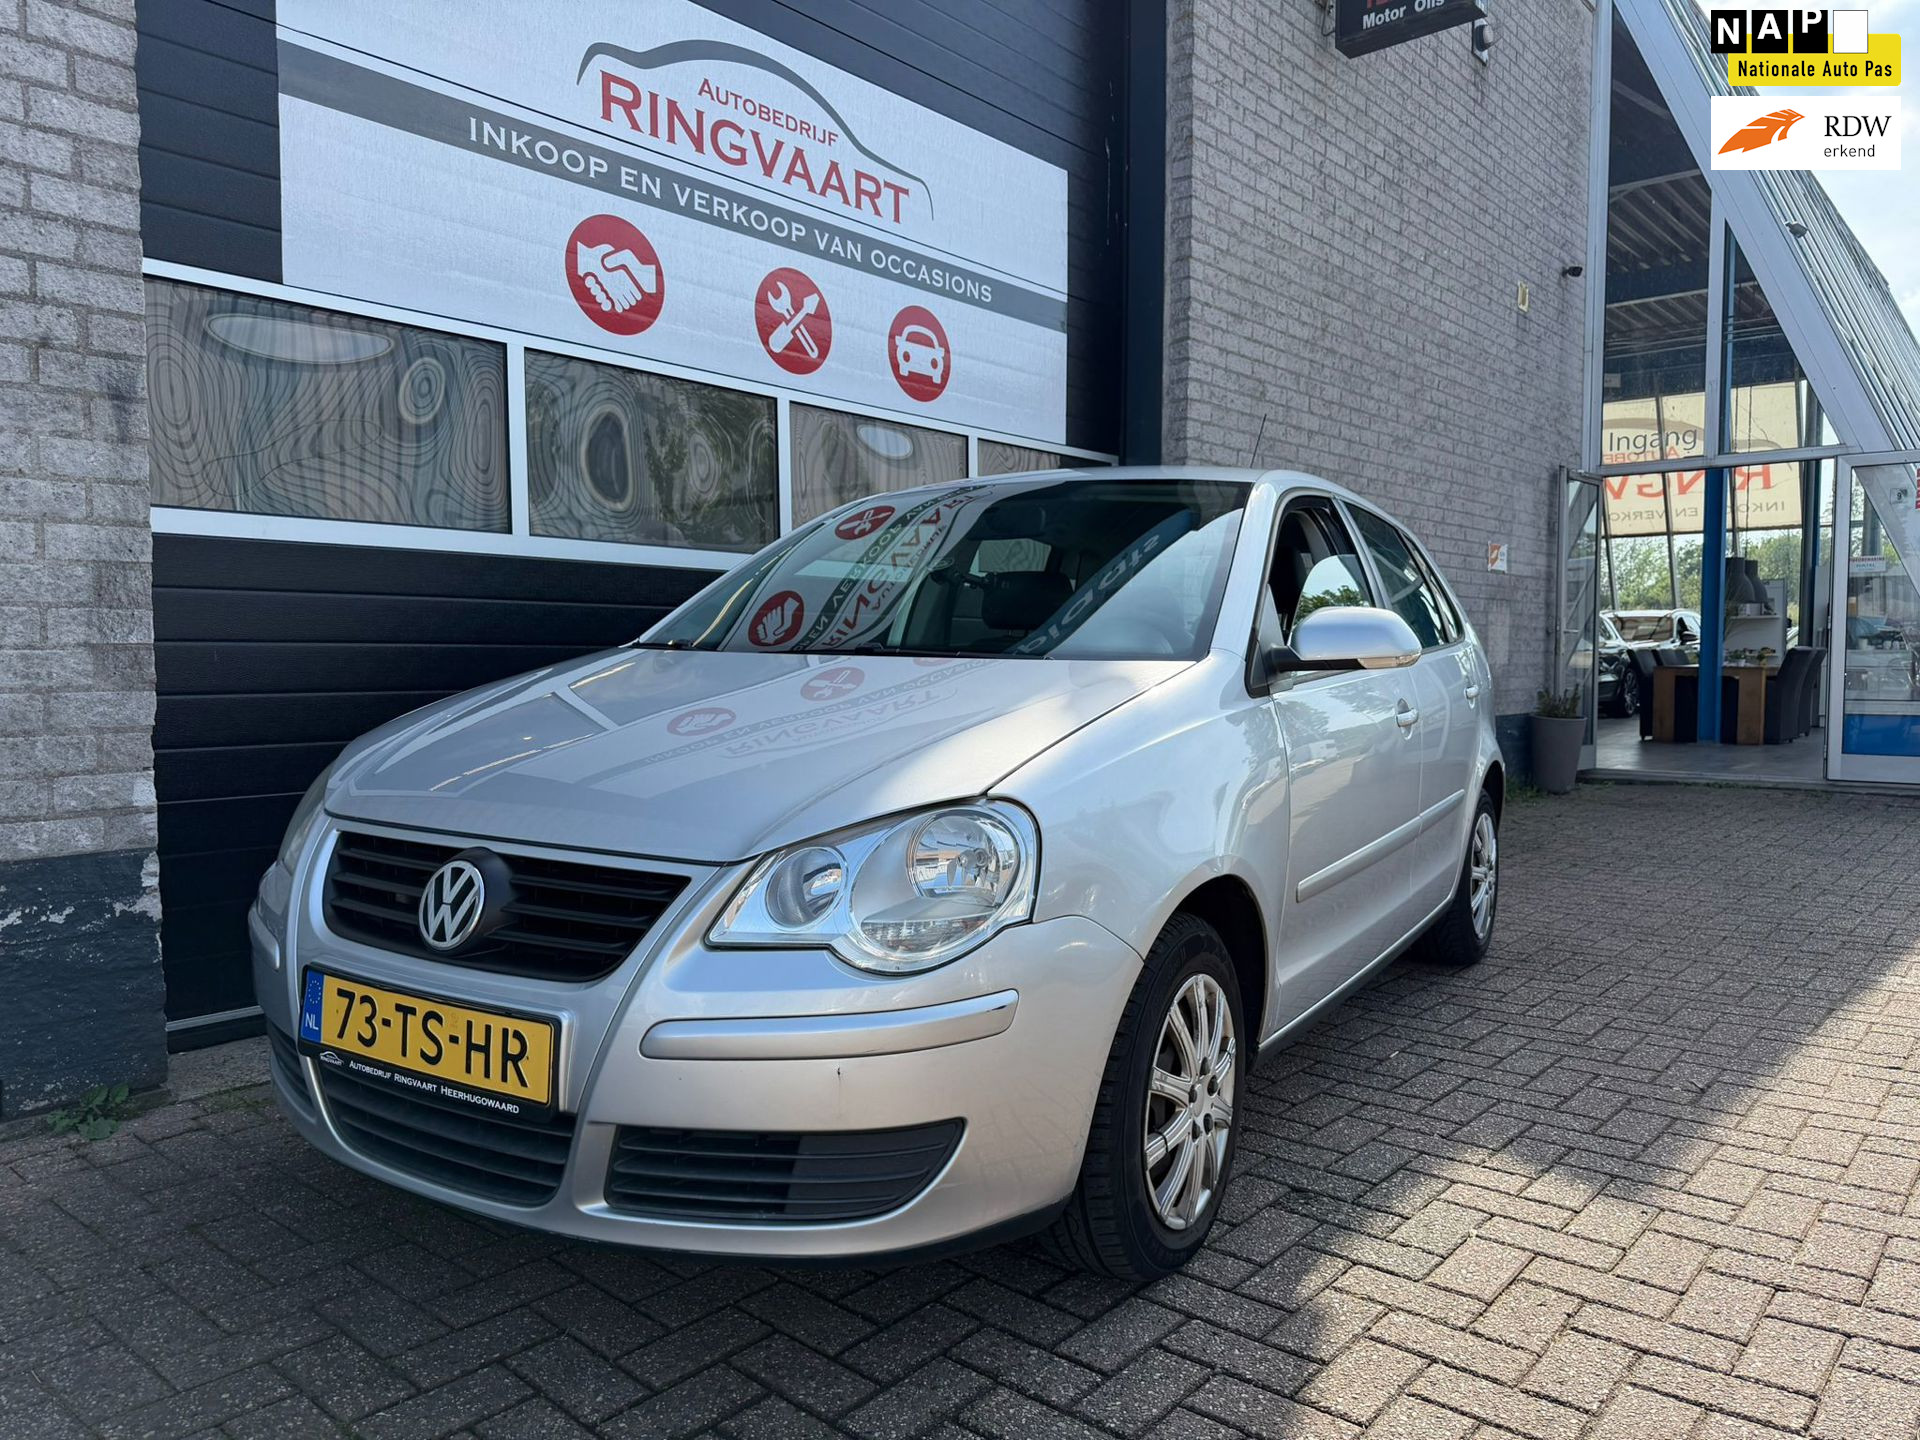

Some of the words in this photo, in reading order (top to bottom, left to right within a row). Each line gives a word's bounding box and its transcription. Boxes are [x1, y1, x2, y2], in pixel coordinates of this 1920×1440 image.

[1362, 5, 1407, 30] Motor
[599, 70, 911, 224] RINGVAART
[697, 78, 839, 148] AUTOBEDRIJF
[469, 117, 608, 179] INKOOP
[620, 166, 662, 199] EN
[672, 183, 806, 242] VERKOOP
[814, 229, 862, 262] VAN
[870, 249, 992, 302] OCCASIONS
[1609, 427, 1698, 455] Ingang
[420, 862, 484, 948] VW
[305, 1012, 319, 1031] NL
[336, 987, 530, 1088] 73-TS-HR
[349, 1060, 392, 1079] AUTOBEDRIJF
[393, 1073, 438, 1094] RINGVAART
[440, 1086, 520, 1114] HEERHUGOWAARD
